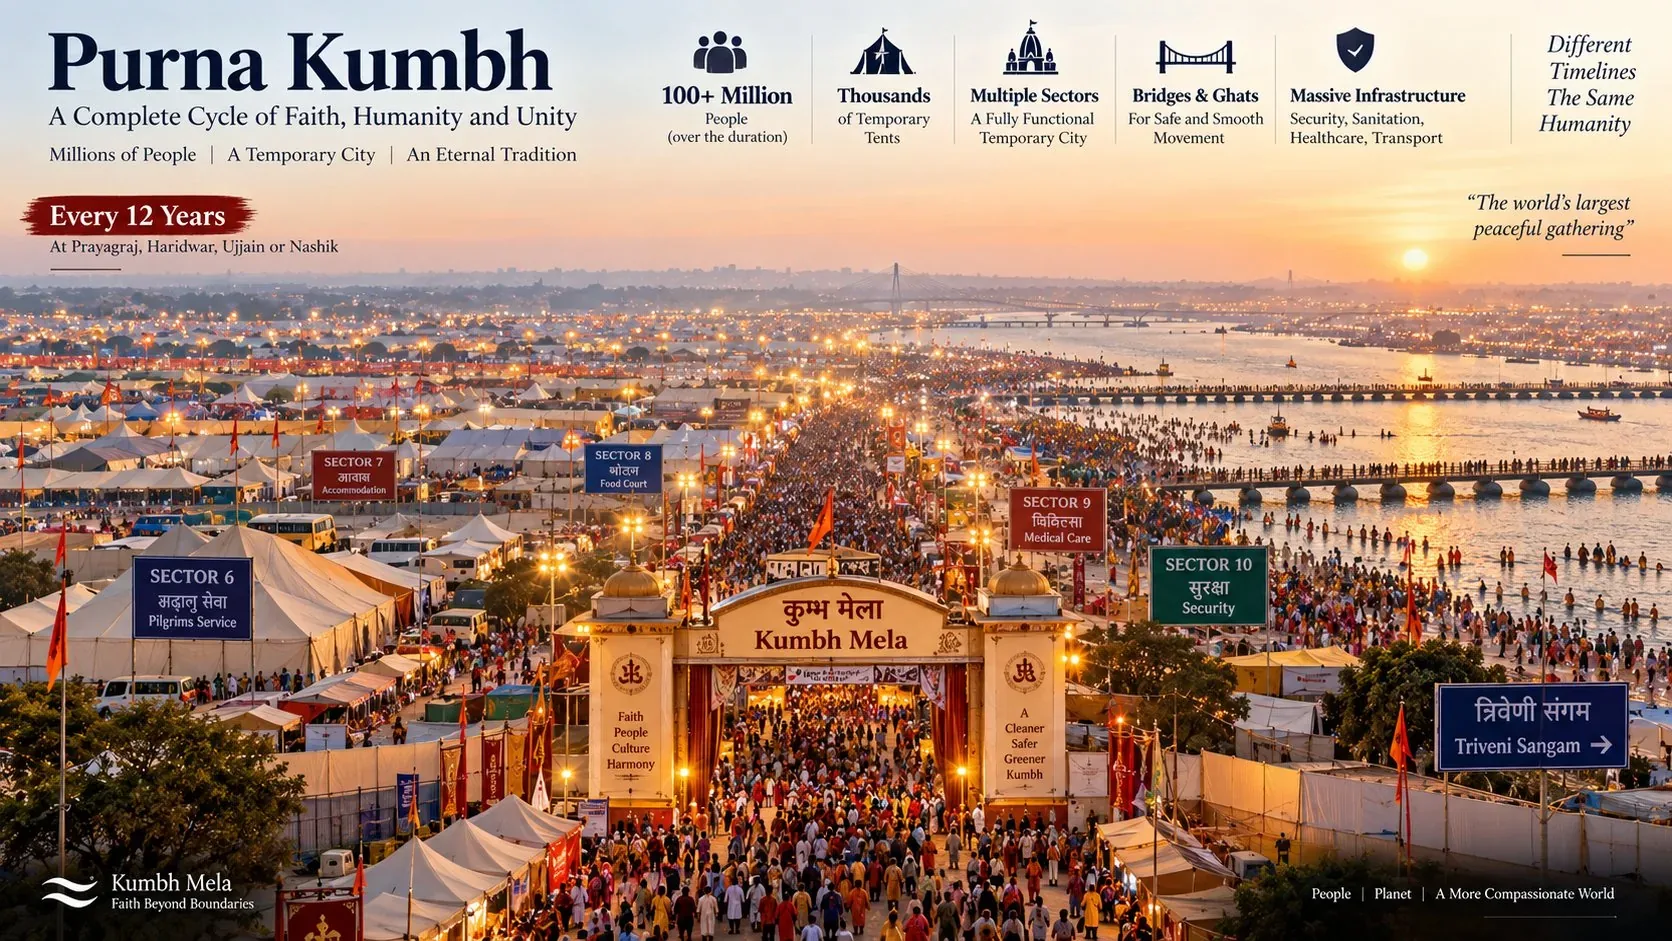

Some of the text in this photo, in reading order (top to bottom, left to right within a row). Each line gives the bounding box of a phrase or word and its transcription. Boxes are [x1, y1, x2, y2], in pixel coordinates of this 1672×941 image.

[596, 451, 651, 460] SECTOR 8
[325, 457, 383, 466] SECTOR 7
[601, 479, 647, 488] Food Court
[322, 486, 386, 494] Accommodation
[1024, 497, 1090, 508] SECTOR 9
[1025, 532, 1091, 543] Medical Care
[1166, 558, 1252, 571] SECTOR 10
[151, 569, 234, 584] SECTOR 6
[1189, 582, 1230, 600] सुरक्षा
[202, 591, 227, 609] सेवा
[783, 592, 884, 626] कुम्भ मेला
[1183, 602, 1235, 617] Security
[150, 615, 236, 630] Pilgrims Service
[755, 629, 908, 649] Kumbh Mela
[1021, 708, 1028, 718] A
[1475, 696, 1591, 722] त्रिवेणी संगम
[619, 711, 643, 721] Faith
[615, 727, 648, 740] People
[1005, 723, 1044, 733] Cleaner
[612, 743, 650, 753] Culture
[1012, 738, 1038, 748] Safer
[1455, 737, 1580, 757] Triveni Sangam
[1004, 754, 1045, 764] Greener
[608, 759, 655, 771] Harmony
[1007, 769, 1043, 779] Kumbh
